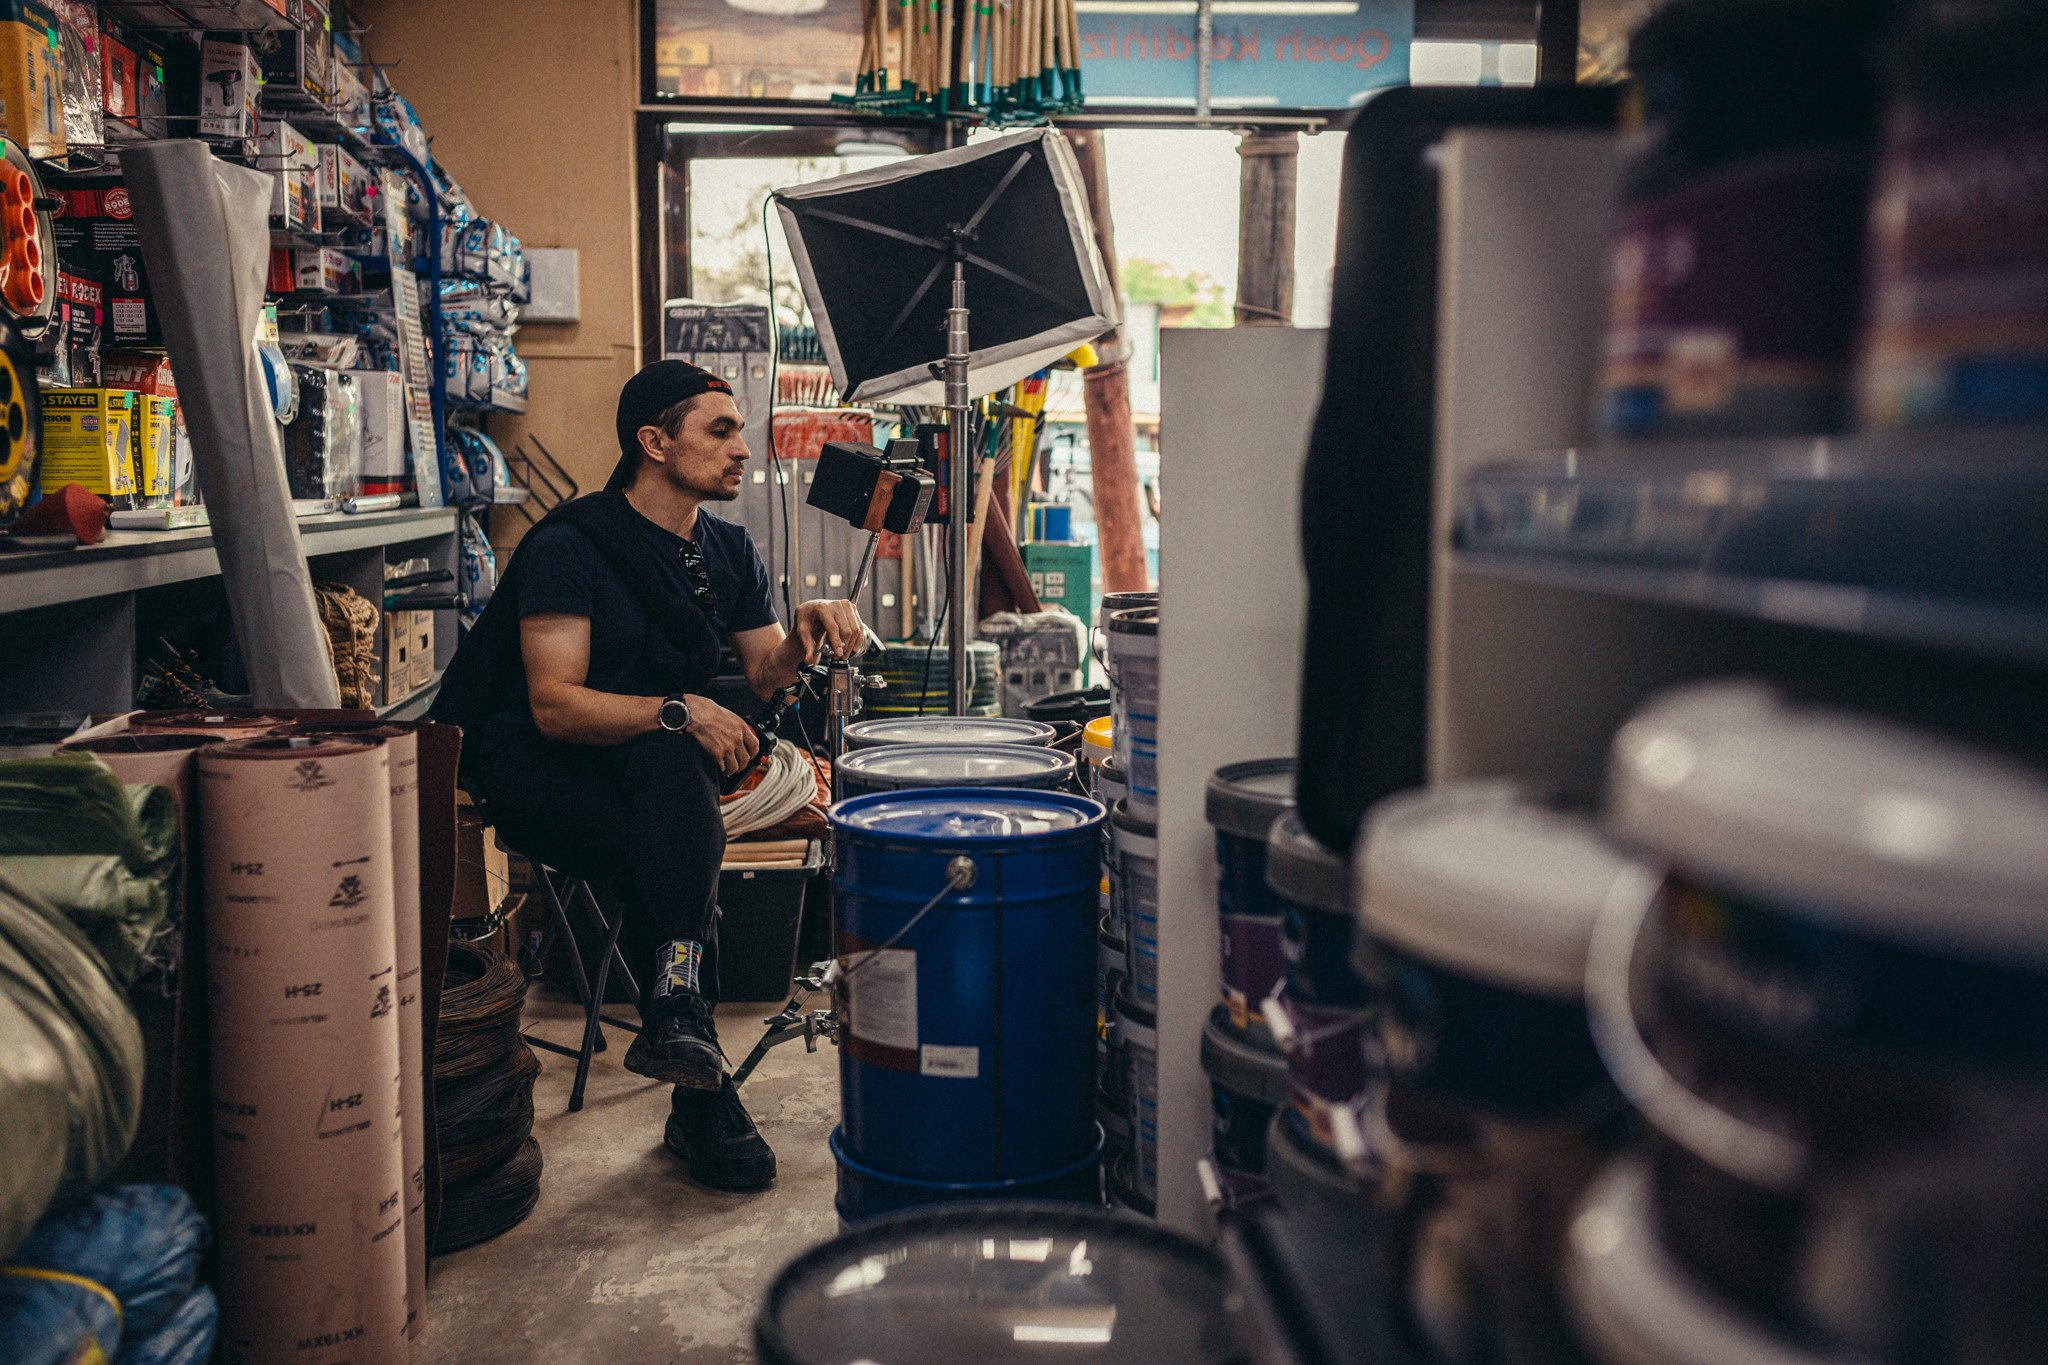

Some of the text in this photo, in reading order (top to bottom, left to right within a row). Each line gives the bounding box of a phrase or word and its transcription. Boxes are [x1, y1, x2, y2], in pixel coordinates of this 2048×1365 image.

[104, 197, 130, 211] RODE
[669, 308, 707, 319] ORIENT
[48, 395, 96, 406] STAYER
[43, 414, 72, 423] RION
[285, 982, 323, 999] 25-H
[330, 1093, 364, 1112] 25-H
[248, 1222, 316, 1237] KK19XW
[296, 1326, 364, 1351] KK19XW
